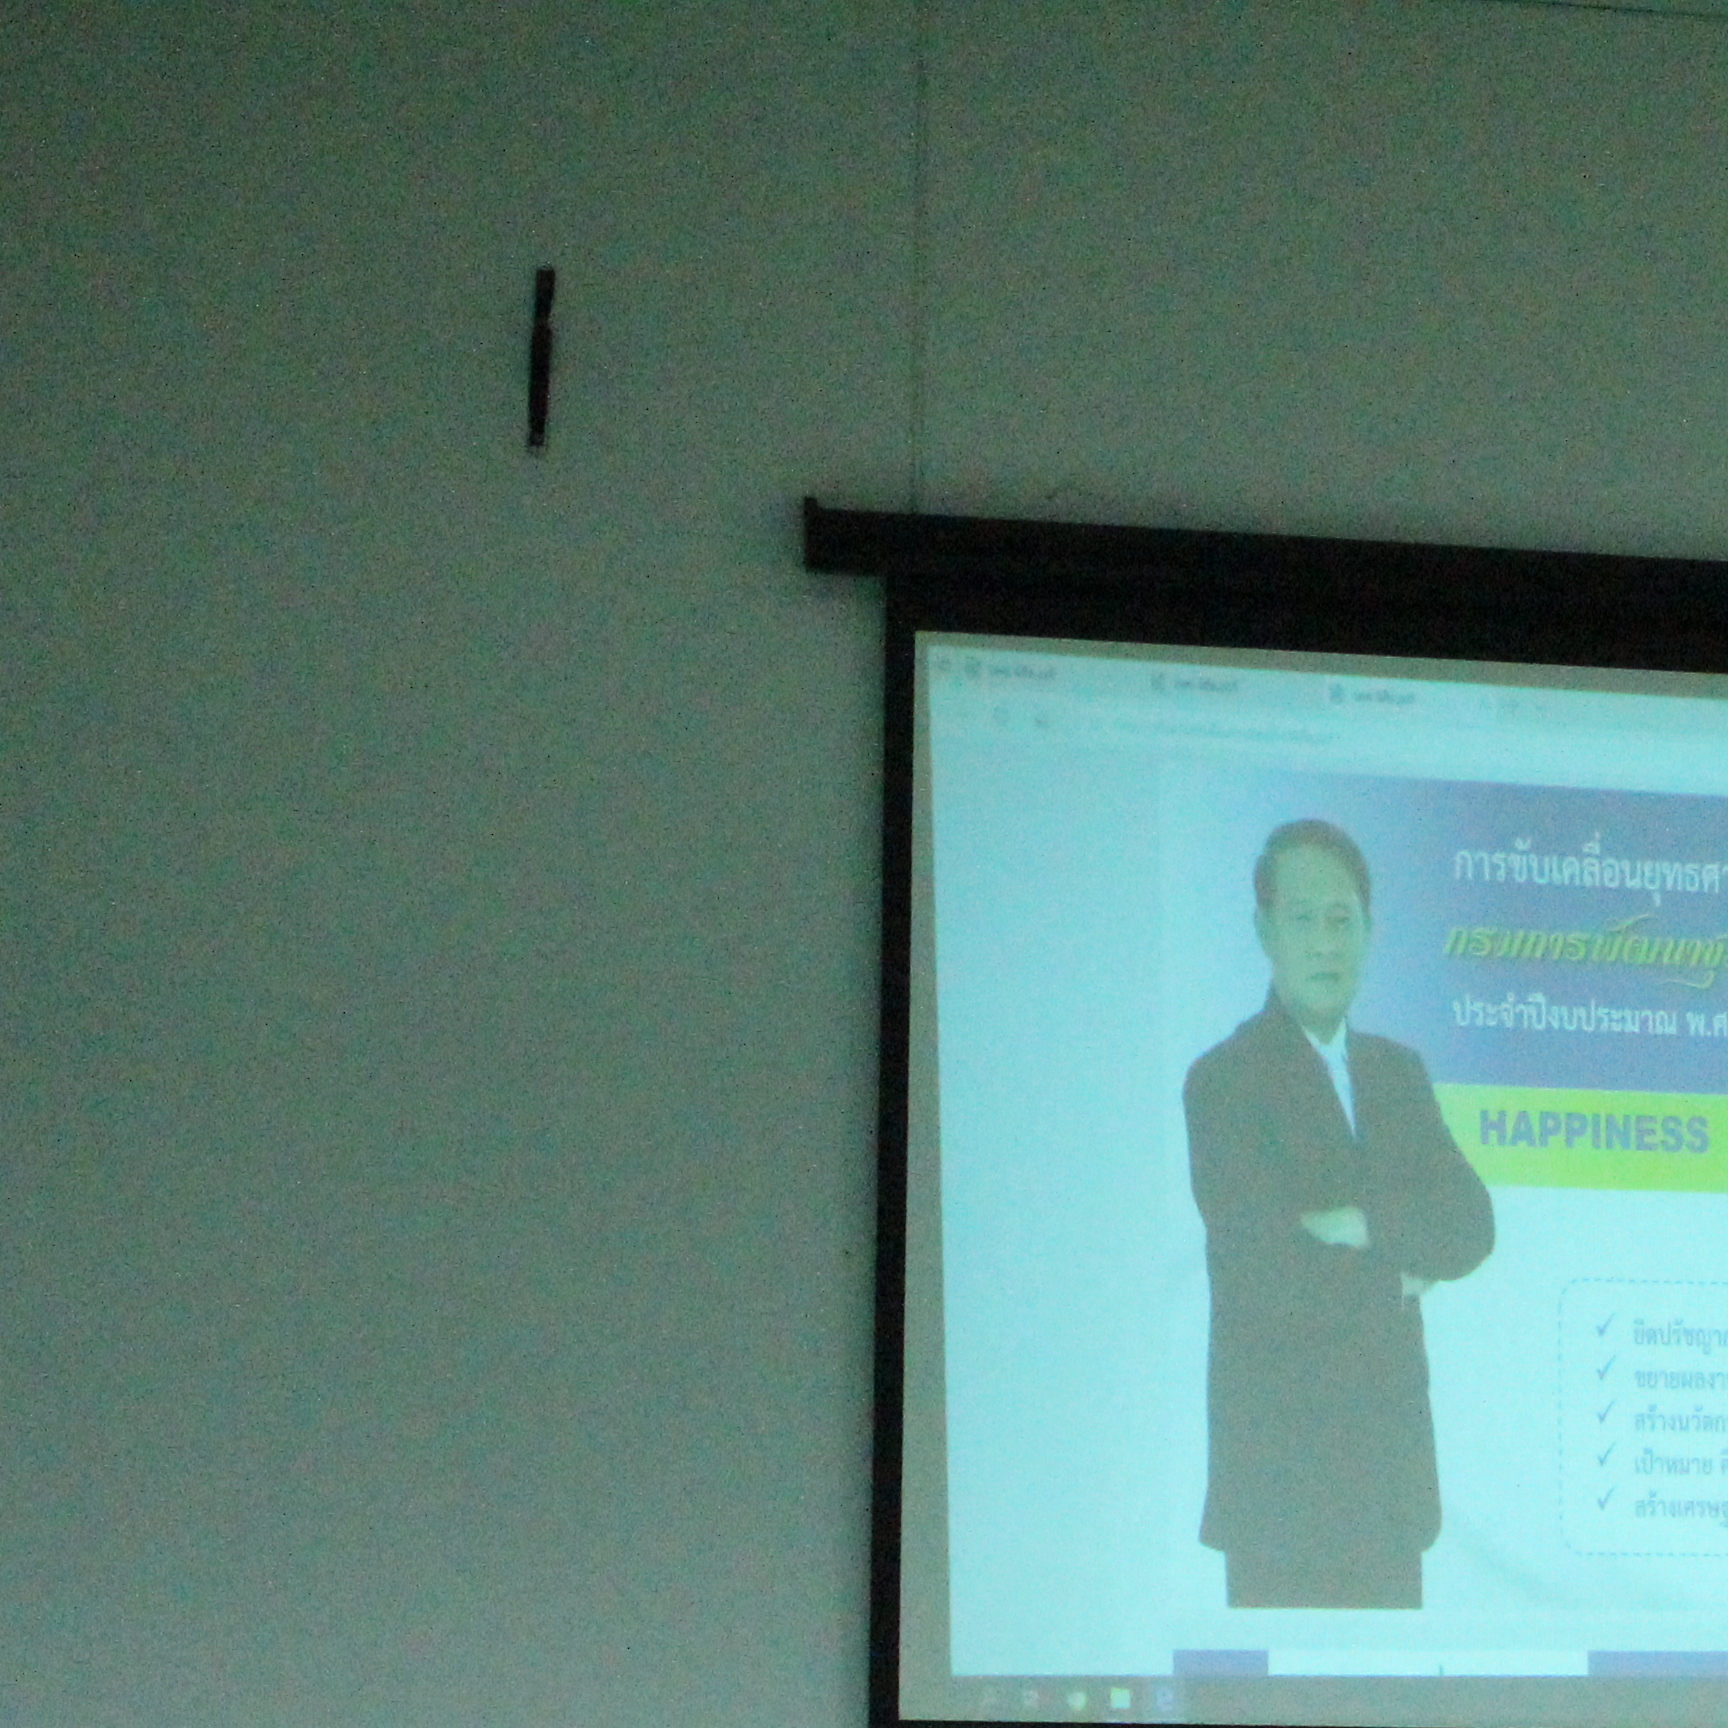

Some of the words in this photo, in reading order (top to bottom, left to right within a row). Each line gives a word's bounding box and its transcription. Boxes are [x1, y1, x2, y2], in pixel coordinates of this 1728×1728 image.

[1452, 991, 1678, 1038] ประจำปีงบประมาณ
[1479, 1109, 1711, 1155] HAPPINESS
